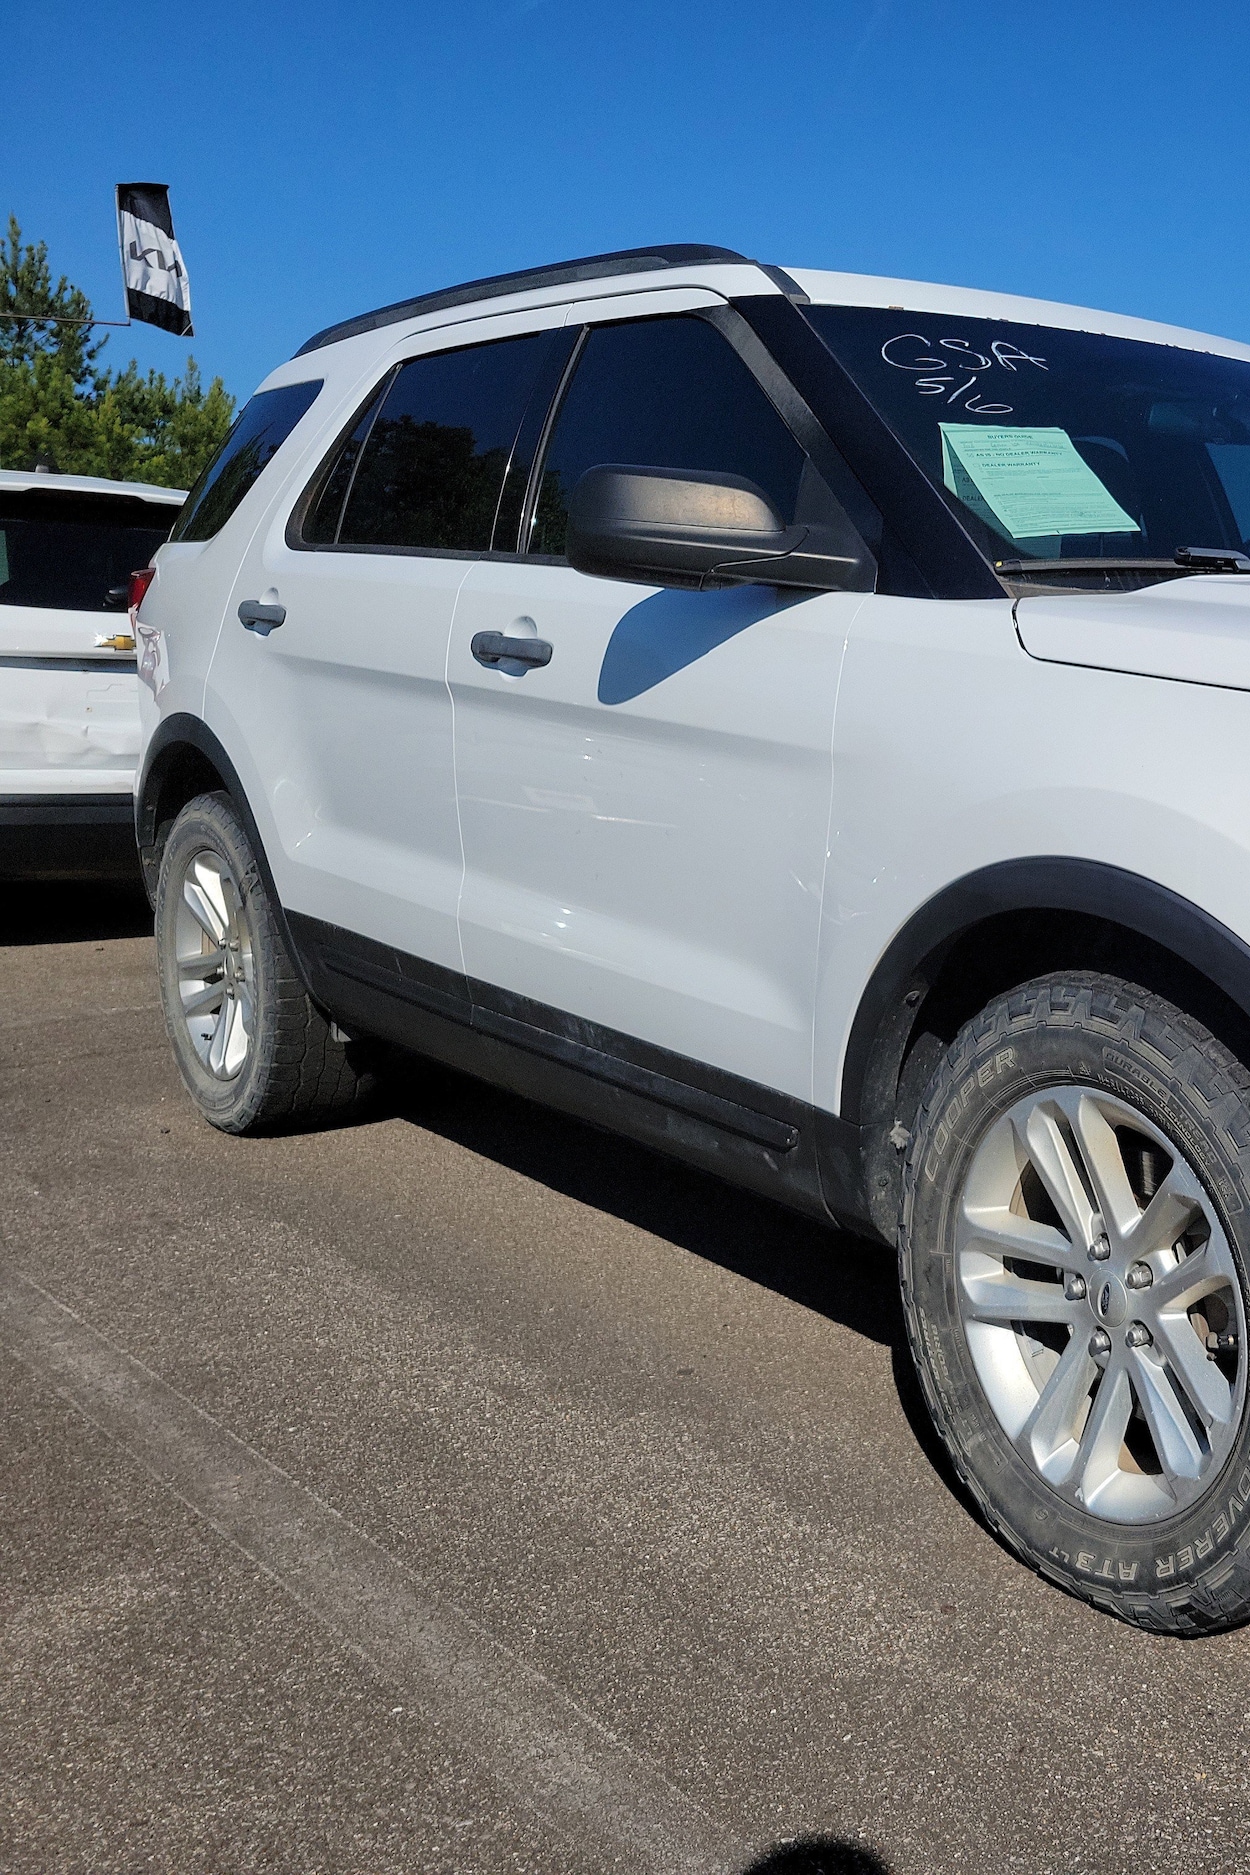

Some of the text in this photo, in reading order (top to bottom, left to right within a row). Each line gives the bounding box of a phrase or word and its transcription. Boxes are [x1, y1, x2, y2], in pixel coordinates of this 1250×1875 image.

[881, 333, 1049, 372] GSA
[914, 375, 1014, 414] 5/6
[924, 1045, 1016, 1182] COOPER
[1159, 1101, 1212, 1166] TECHNOLOGY
[1075, 1551, 1139, 1581] AT3
